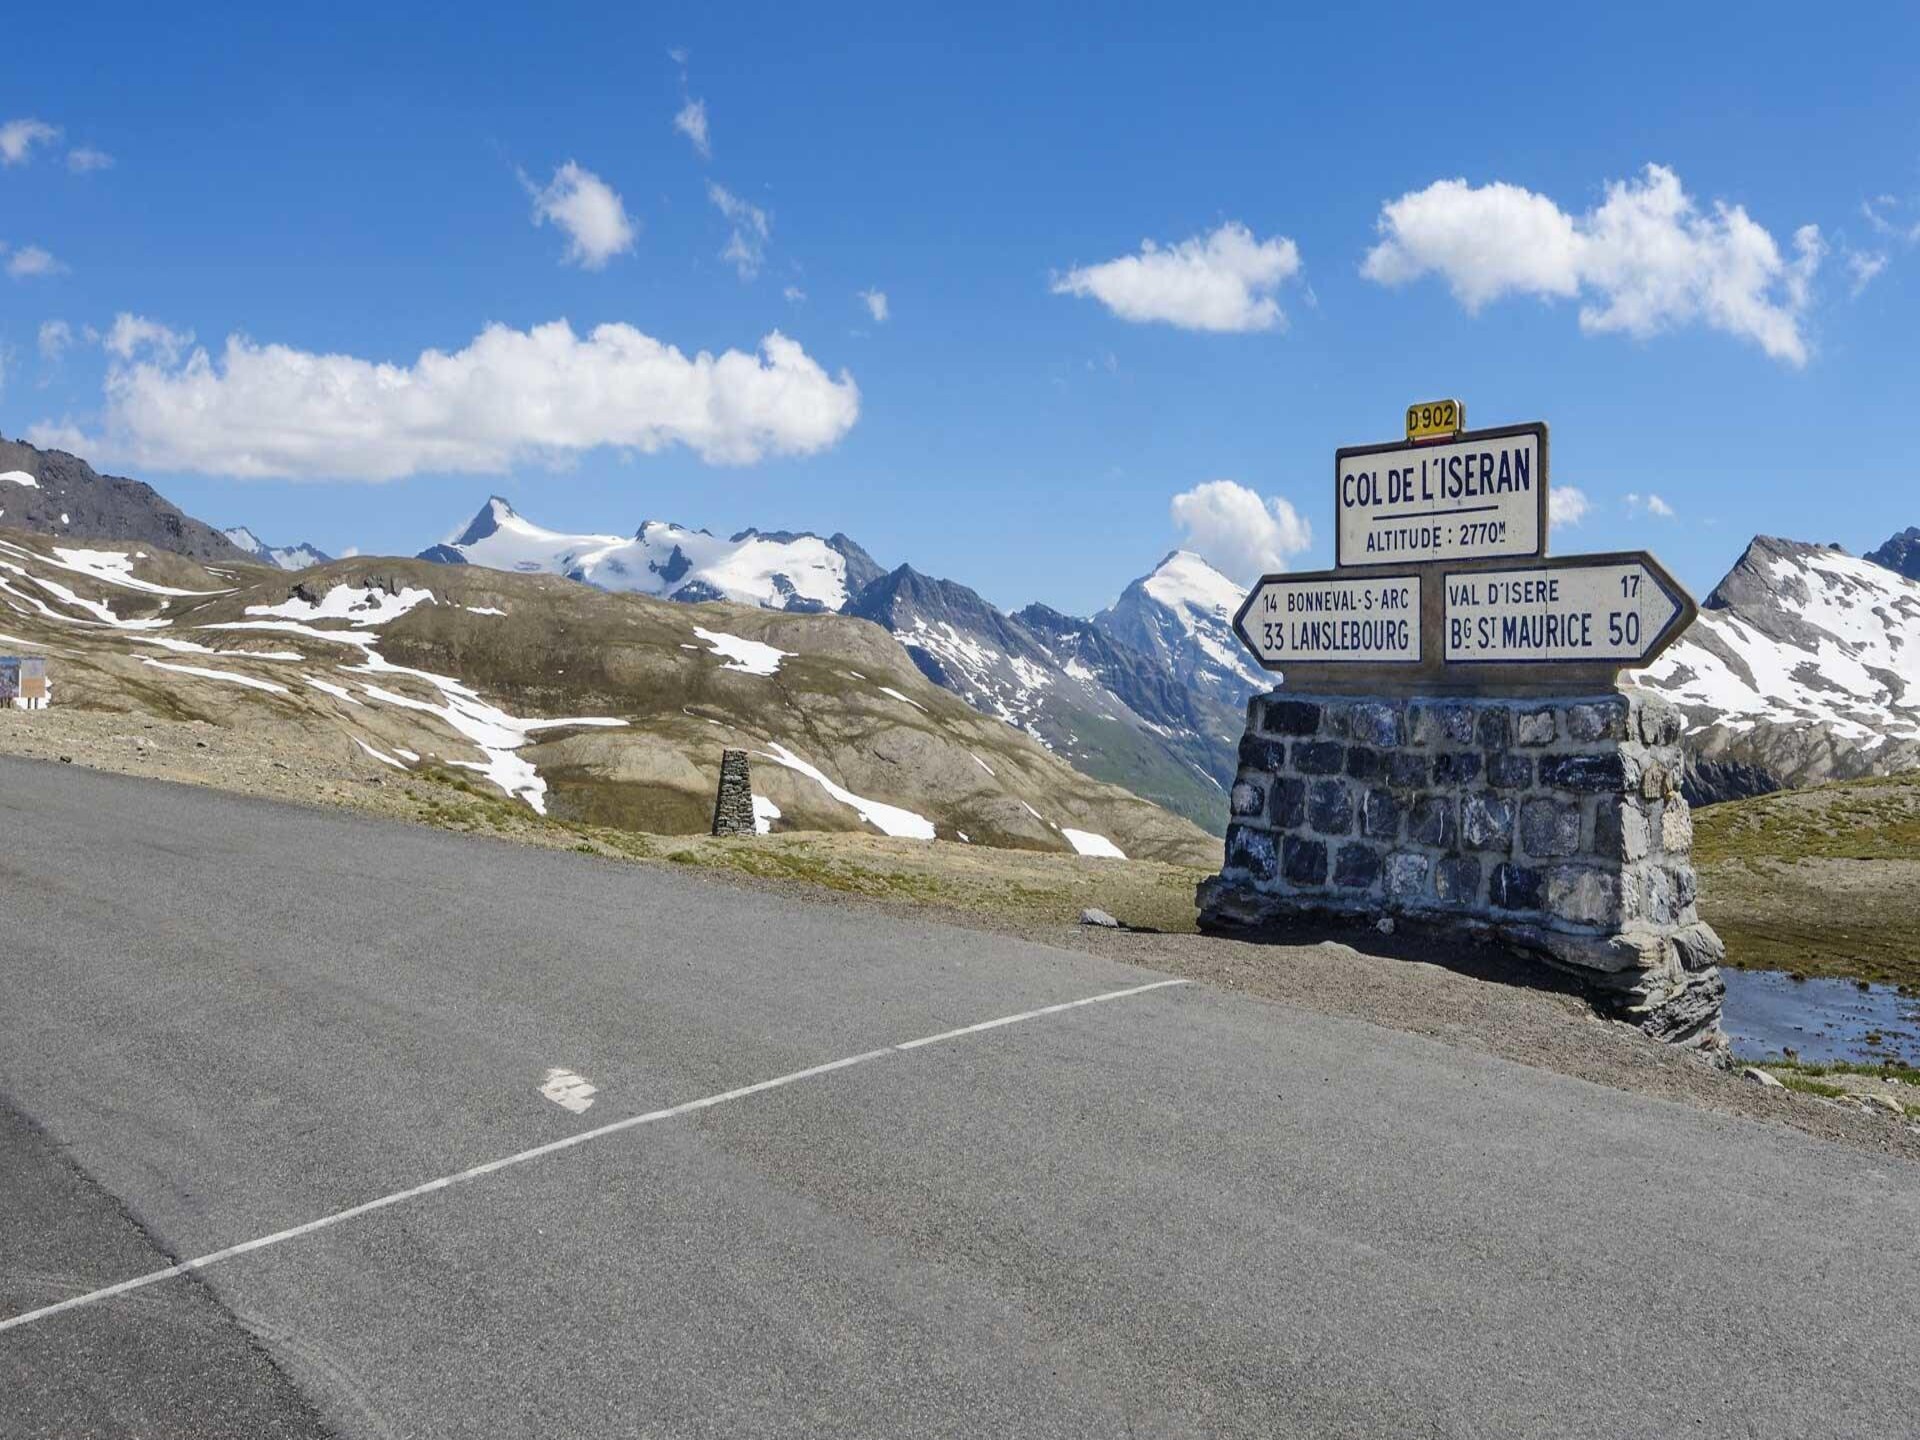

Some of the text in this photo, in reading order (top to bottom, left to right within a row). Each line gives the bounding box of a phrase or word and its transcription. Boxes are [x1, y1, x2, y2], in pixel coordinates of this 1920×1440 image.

[1343, 447, 1530, 508] COL DE L'ISERAN
[1264, 593, 1277, 612] 14
[1449, 574, 1640, 607] VAL D'ISERE 17
[1263, 620, 1409, 651] 33 LANSLEBOURG
[1502, 613, 1592, 649] MAURICE
[1608, 611, 1640, 646] 50
